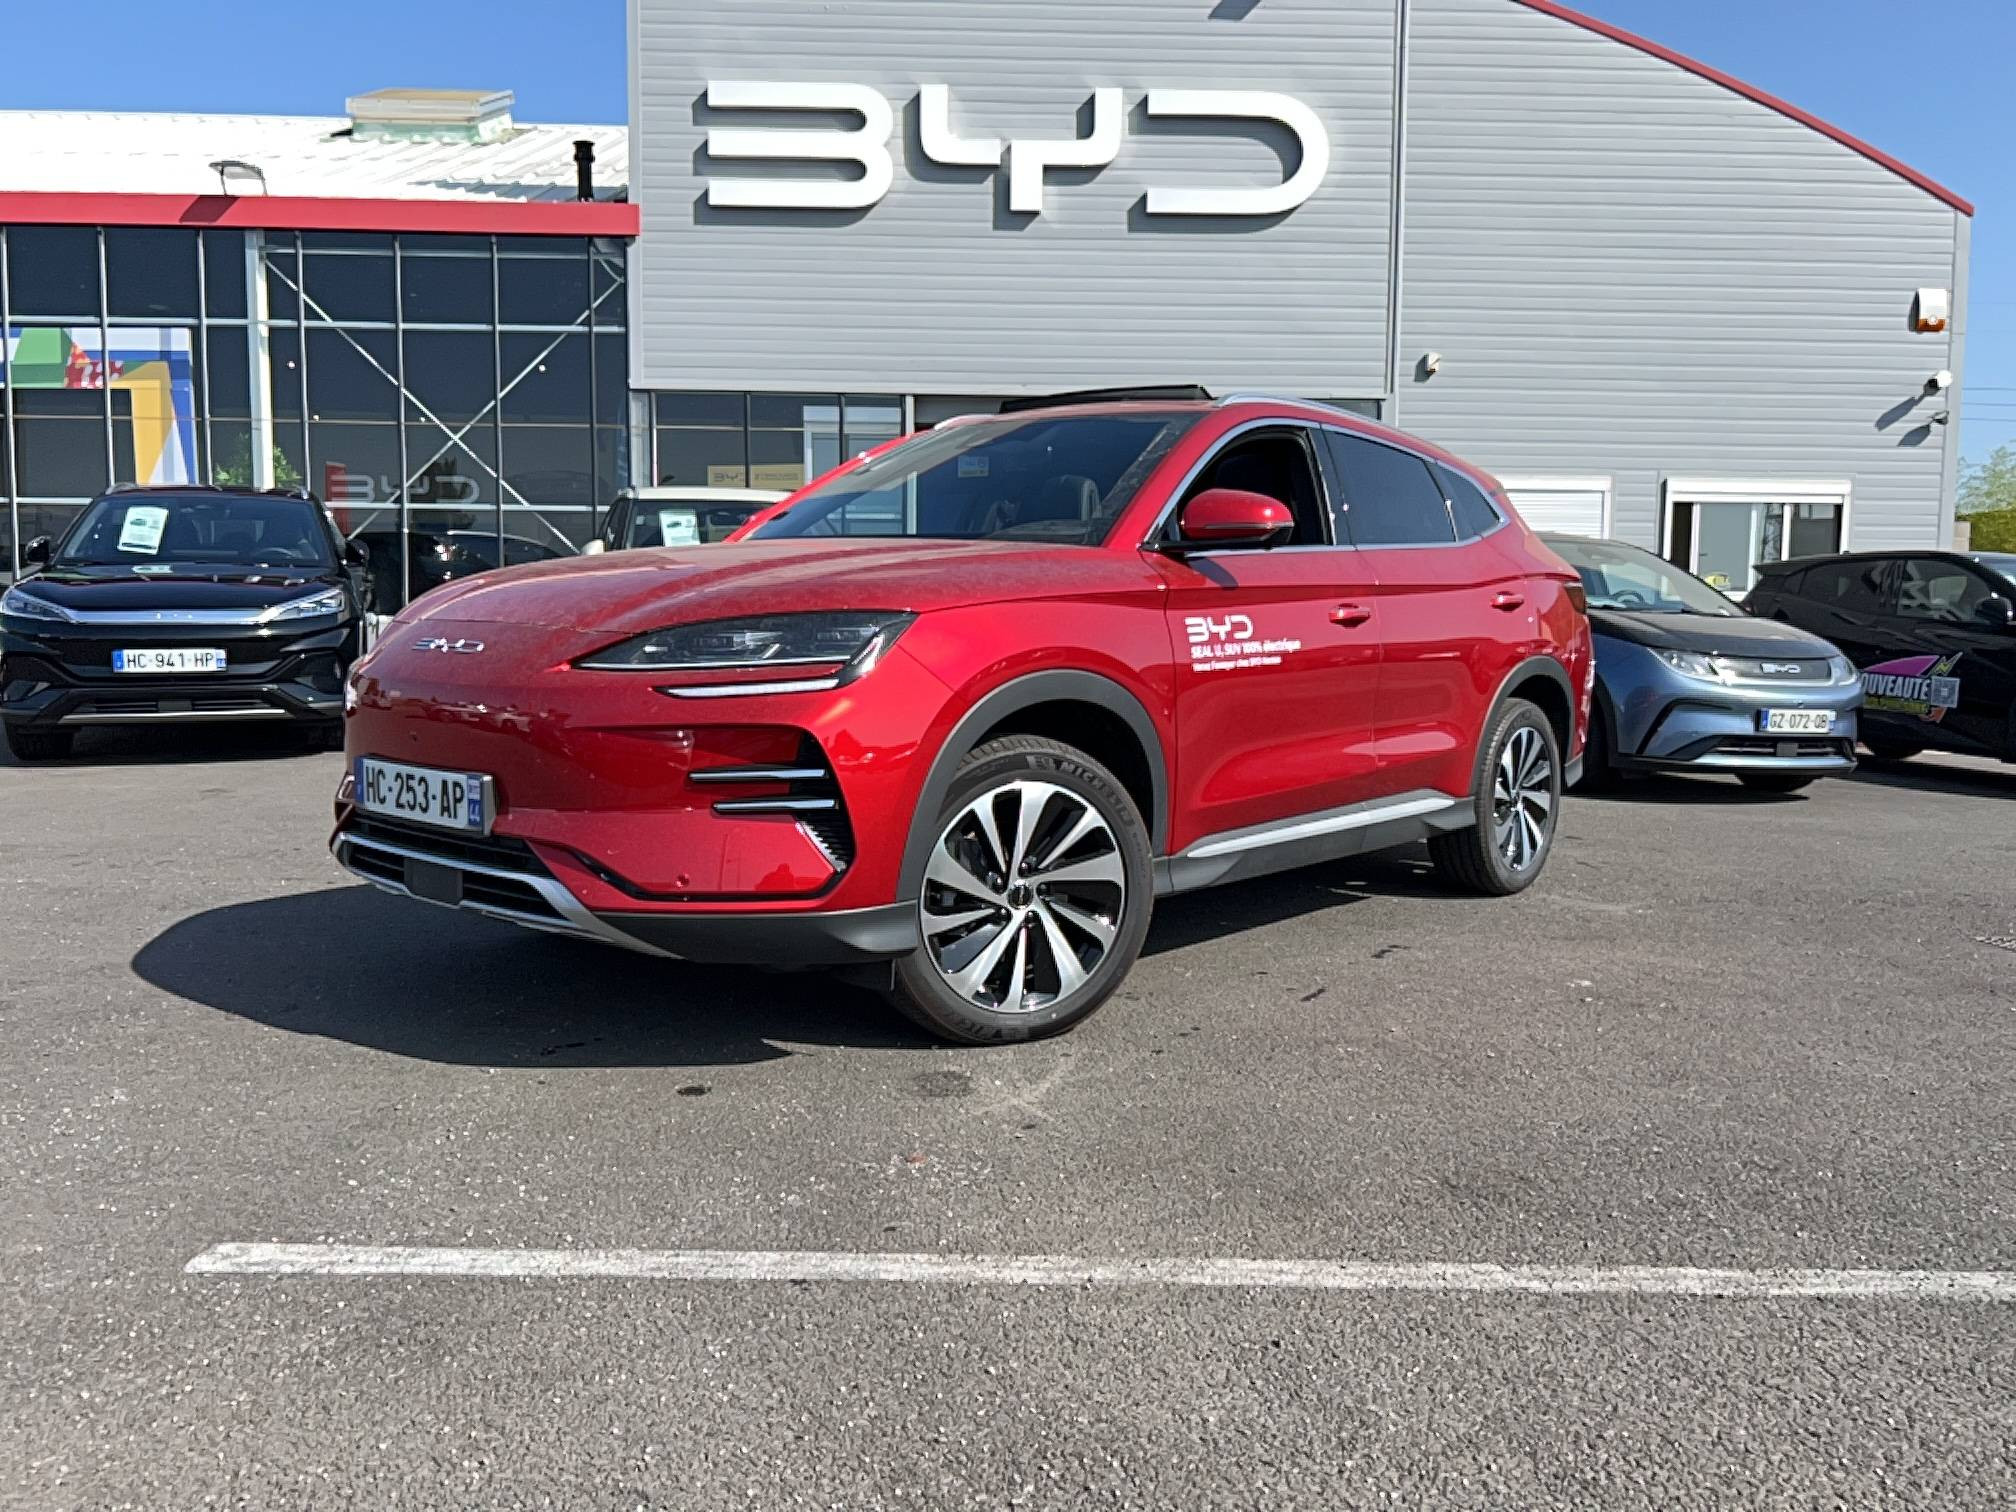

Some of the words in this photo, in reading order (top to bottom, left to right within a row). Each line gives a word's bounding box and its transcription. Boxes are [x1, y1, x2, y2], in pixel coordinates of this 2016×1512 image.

[706, 79, 1330, 215] BYD
[330, 474, 480, 504] BYD
[1184, 615, 1253, 643] BYD
[127, 652, 213, 669] HC-941-HP
[1191, 645, 1214, 659] SEAL
[365, 765, 465, 820] HC-253-AP
